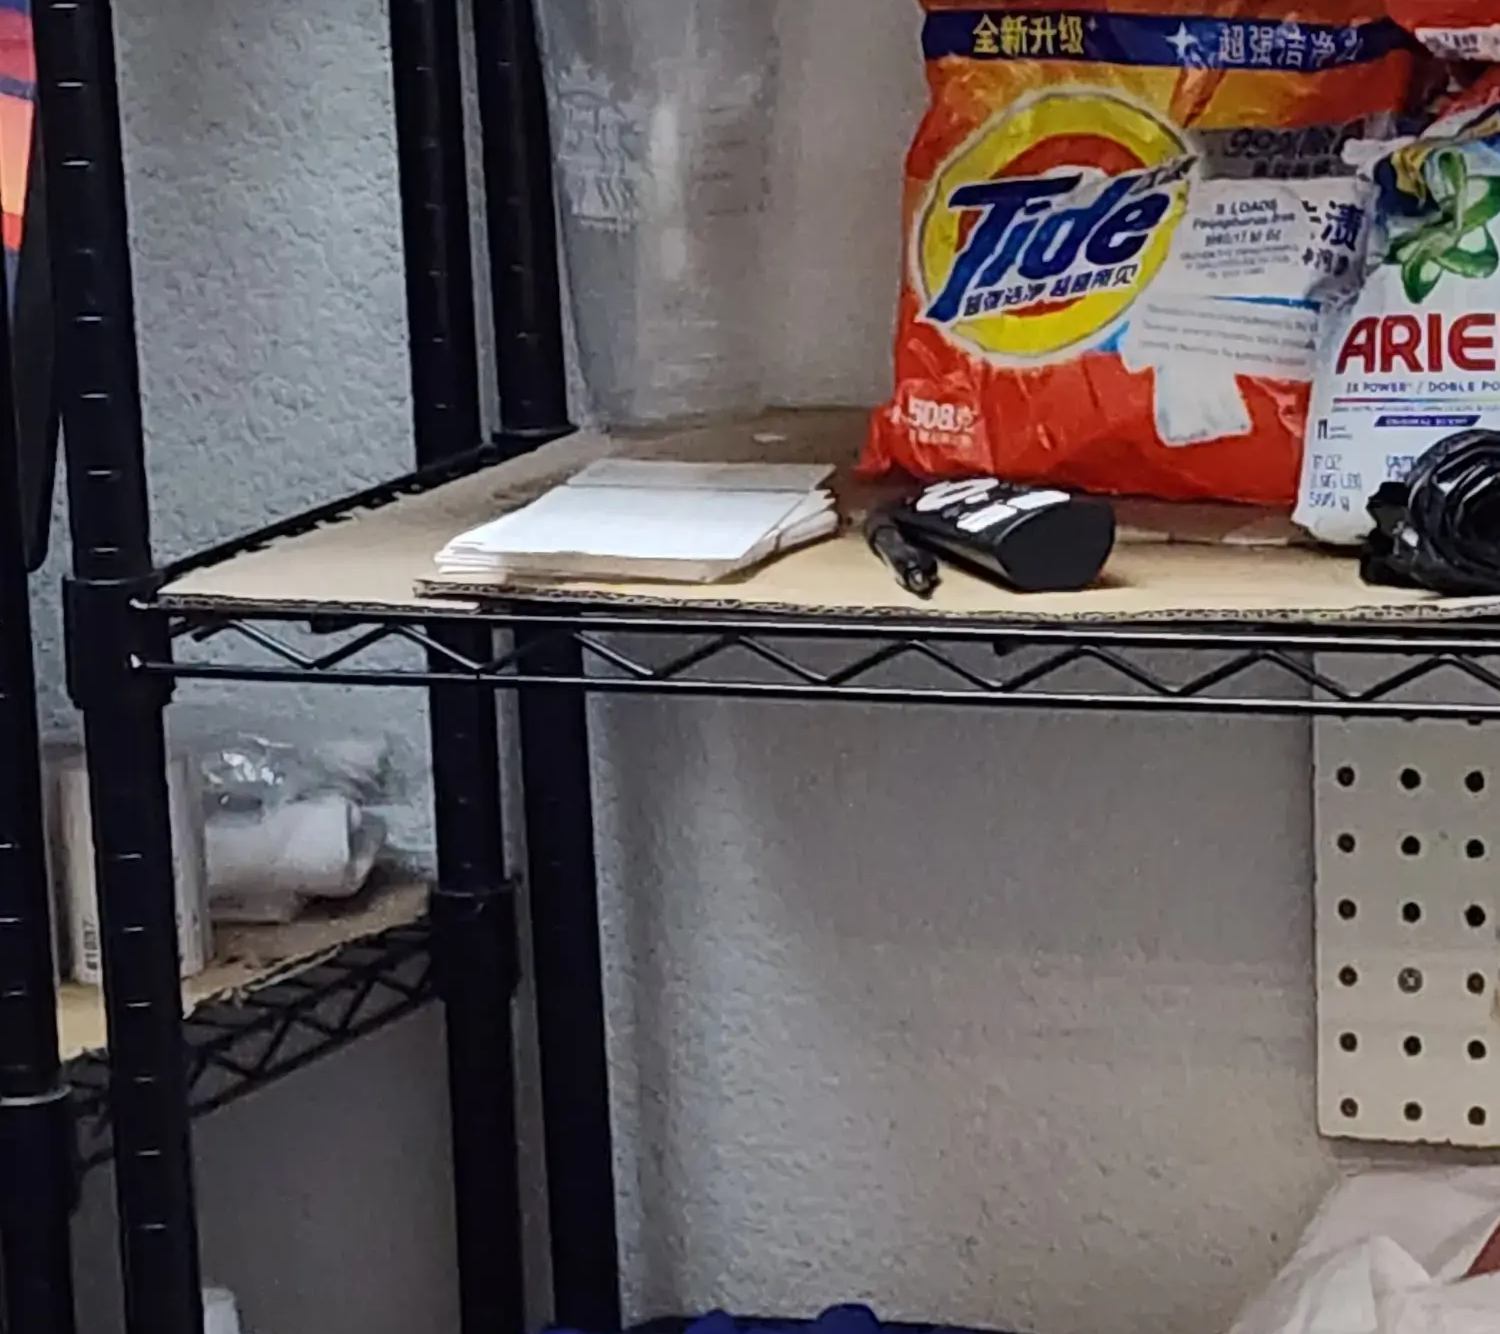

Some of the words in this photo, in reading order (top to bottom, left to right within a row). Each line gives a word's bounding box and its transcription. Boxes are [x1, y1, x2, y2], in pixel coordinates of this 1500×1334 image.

[972, 13, 1085, 55] 全新升级
[926, 170, 1171, 323] Tide
